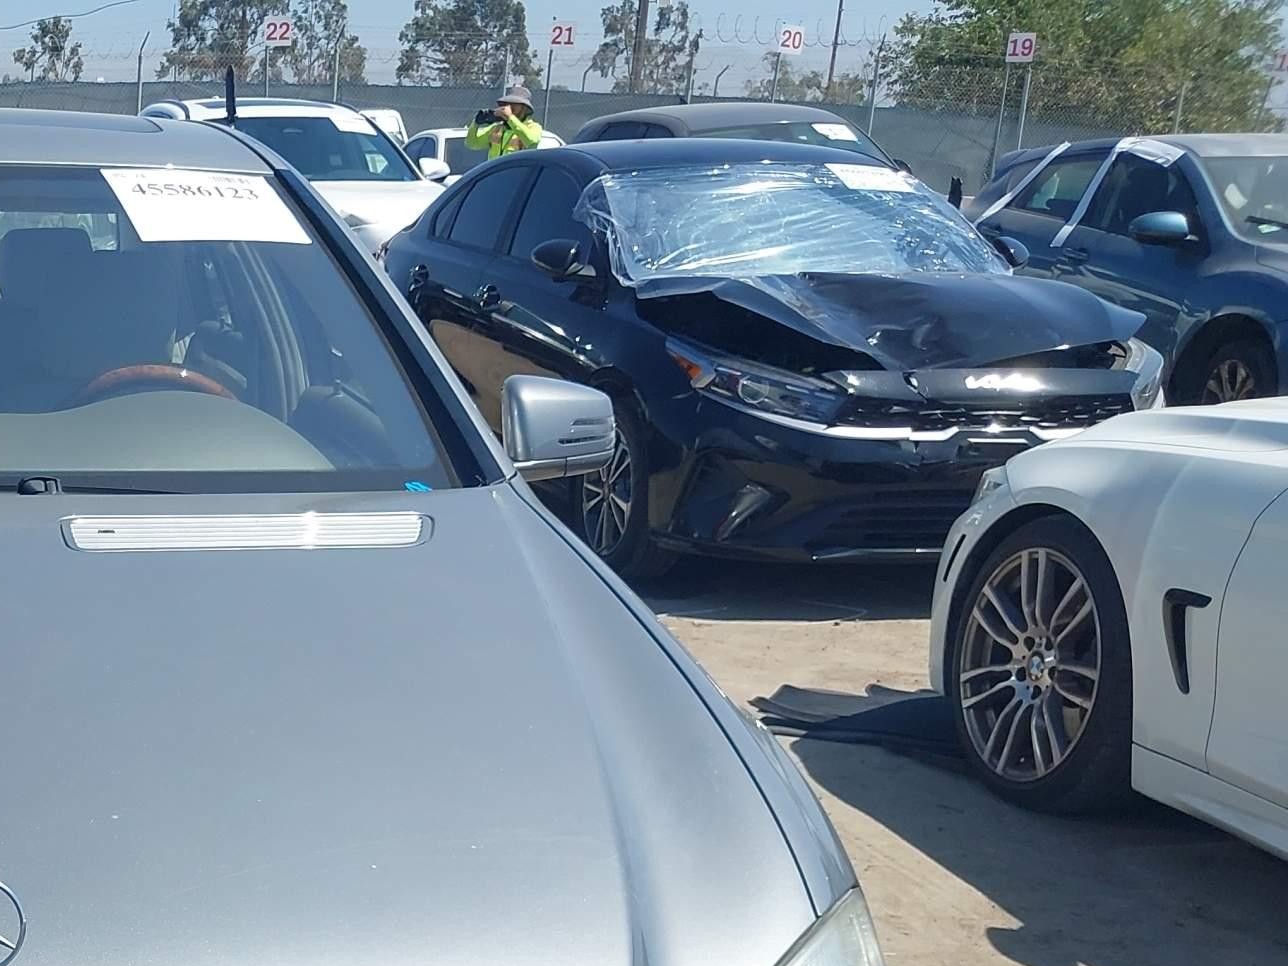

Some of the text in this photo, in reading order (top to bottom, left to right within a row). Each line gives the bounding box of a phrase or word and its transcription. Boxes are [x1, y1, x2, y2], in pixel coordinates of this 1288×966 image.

[266, 22, 290, 40] 22
[551, 26, 574, 45] 21
[781, 30, 802, 49] 20
[1007, 38, 1034, 57] 19
[131, 183, 260, 200] 45586123
